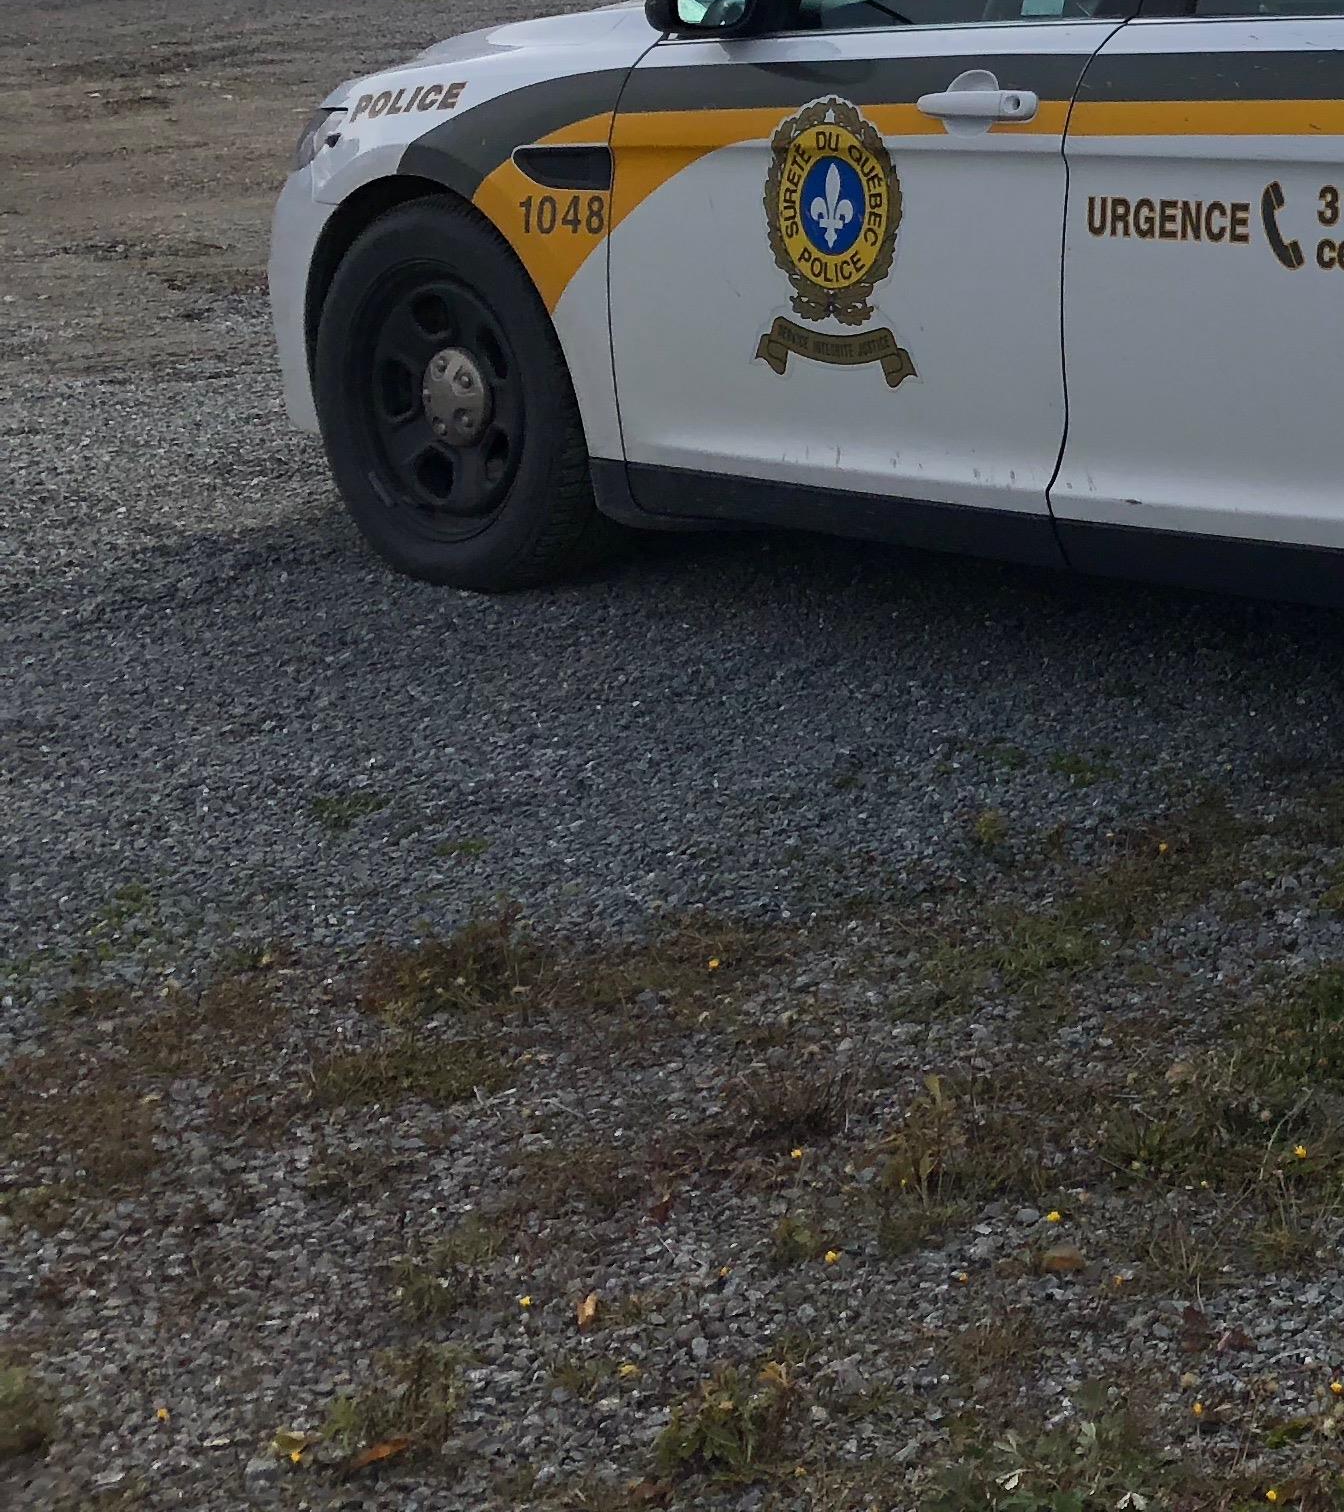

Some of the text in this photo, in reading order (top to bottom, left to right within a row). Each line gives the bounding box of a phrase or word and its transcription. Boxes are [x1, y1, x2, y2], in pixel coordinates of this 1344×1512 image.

[350, 81, 467, 122] POLICE
[815, 131, 840, 152] DU
[847, 144, 884, 248] QUÉBEC
[519, 194, 605, 235] 1048
[1087, 195, 1250, 244] URGENCE
[797, 246, 866, 283] POLICE
